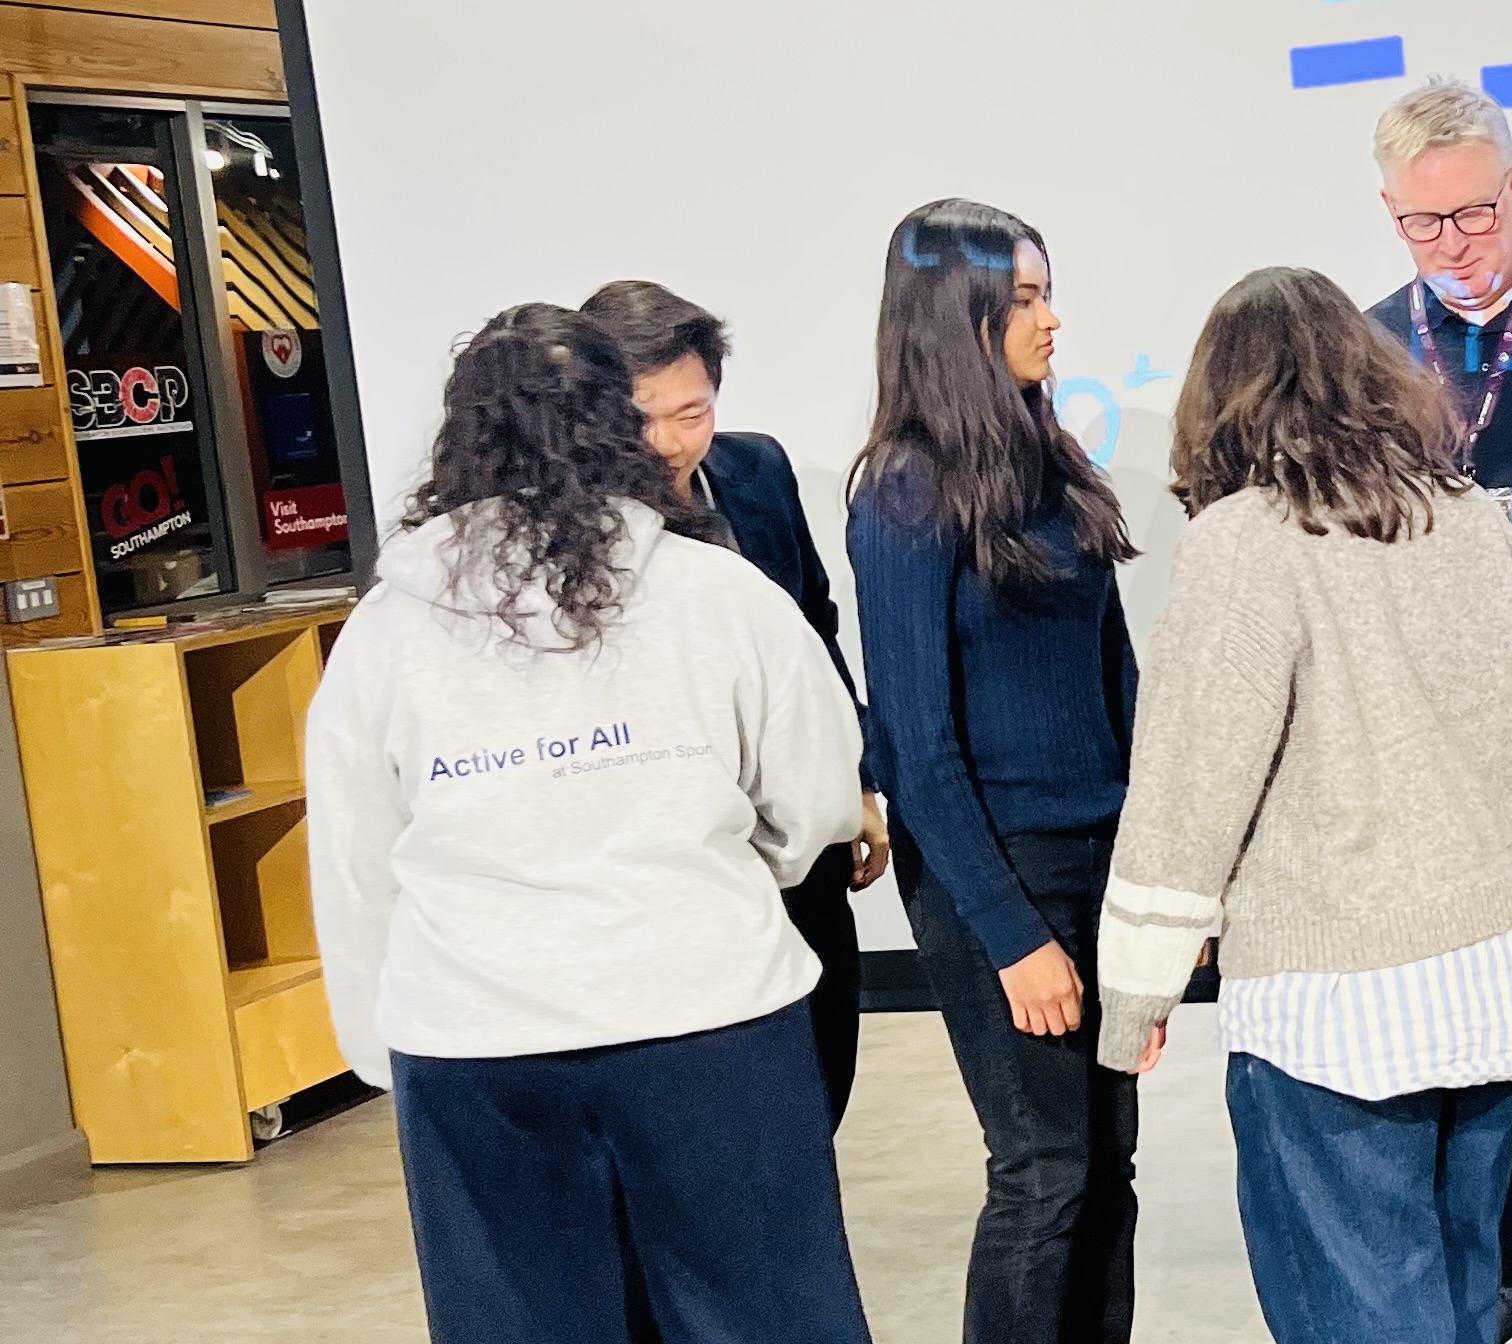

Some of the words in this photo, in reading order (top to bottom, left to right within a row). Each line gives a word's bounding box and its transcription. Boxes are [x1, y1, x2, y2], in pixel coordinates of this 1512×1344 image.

[67, 366, 189, 430] SBCP
[101, 455, 185, 539] GO!
[270, 500, 298, 517] Visit
[110, 510, 191, 559] SOUTHAMPTON
[430, 747, 526, 781] Active
[536, 737, 580, 761] for
[590, 722, 631, 751] All
[552, 766, 567, 779] at
[571, 749, 671, 775] Southampton
